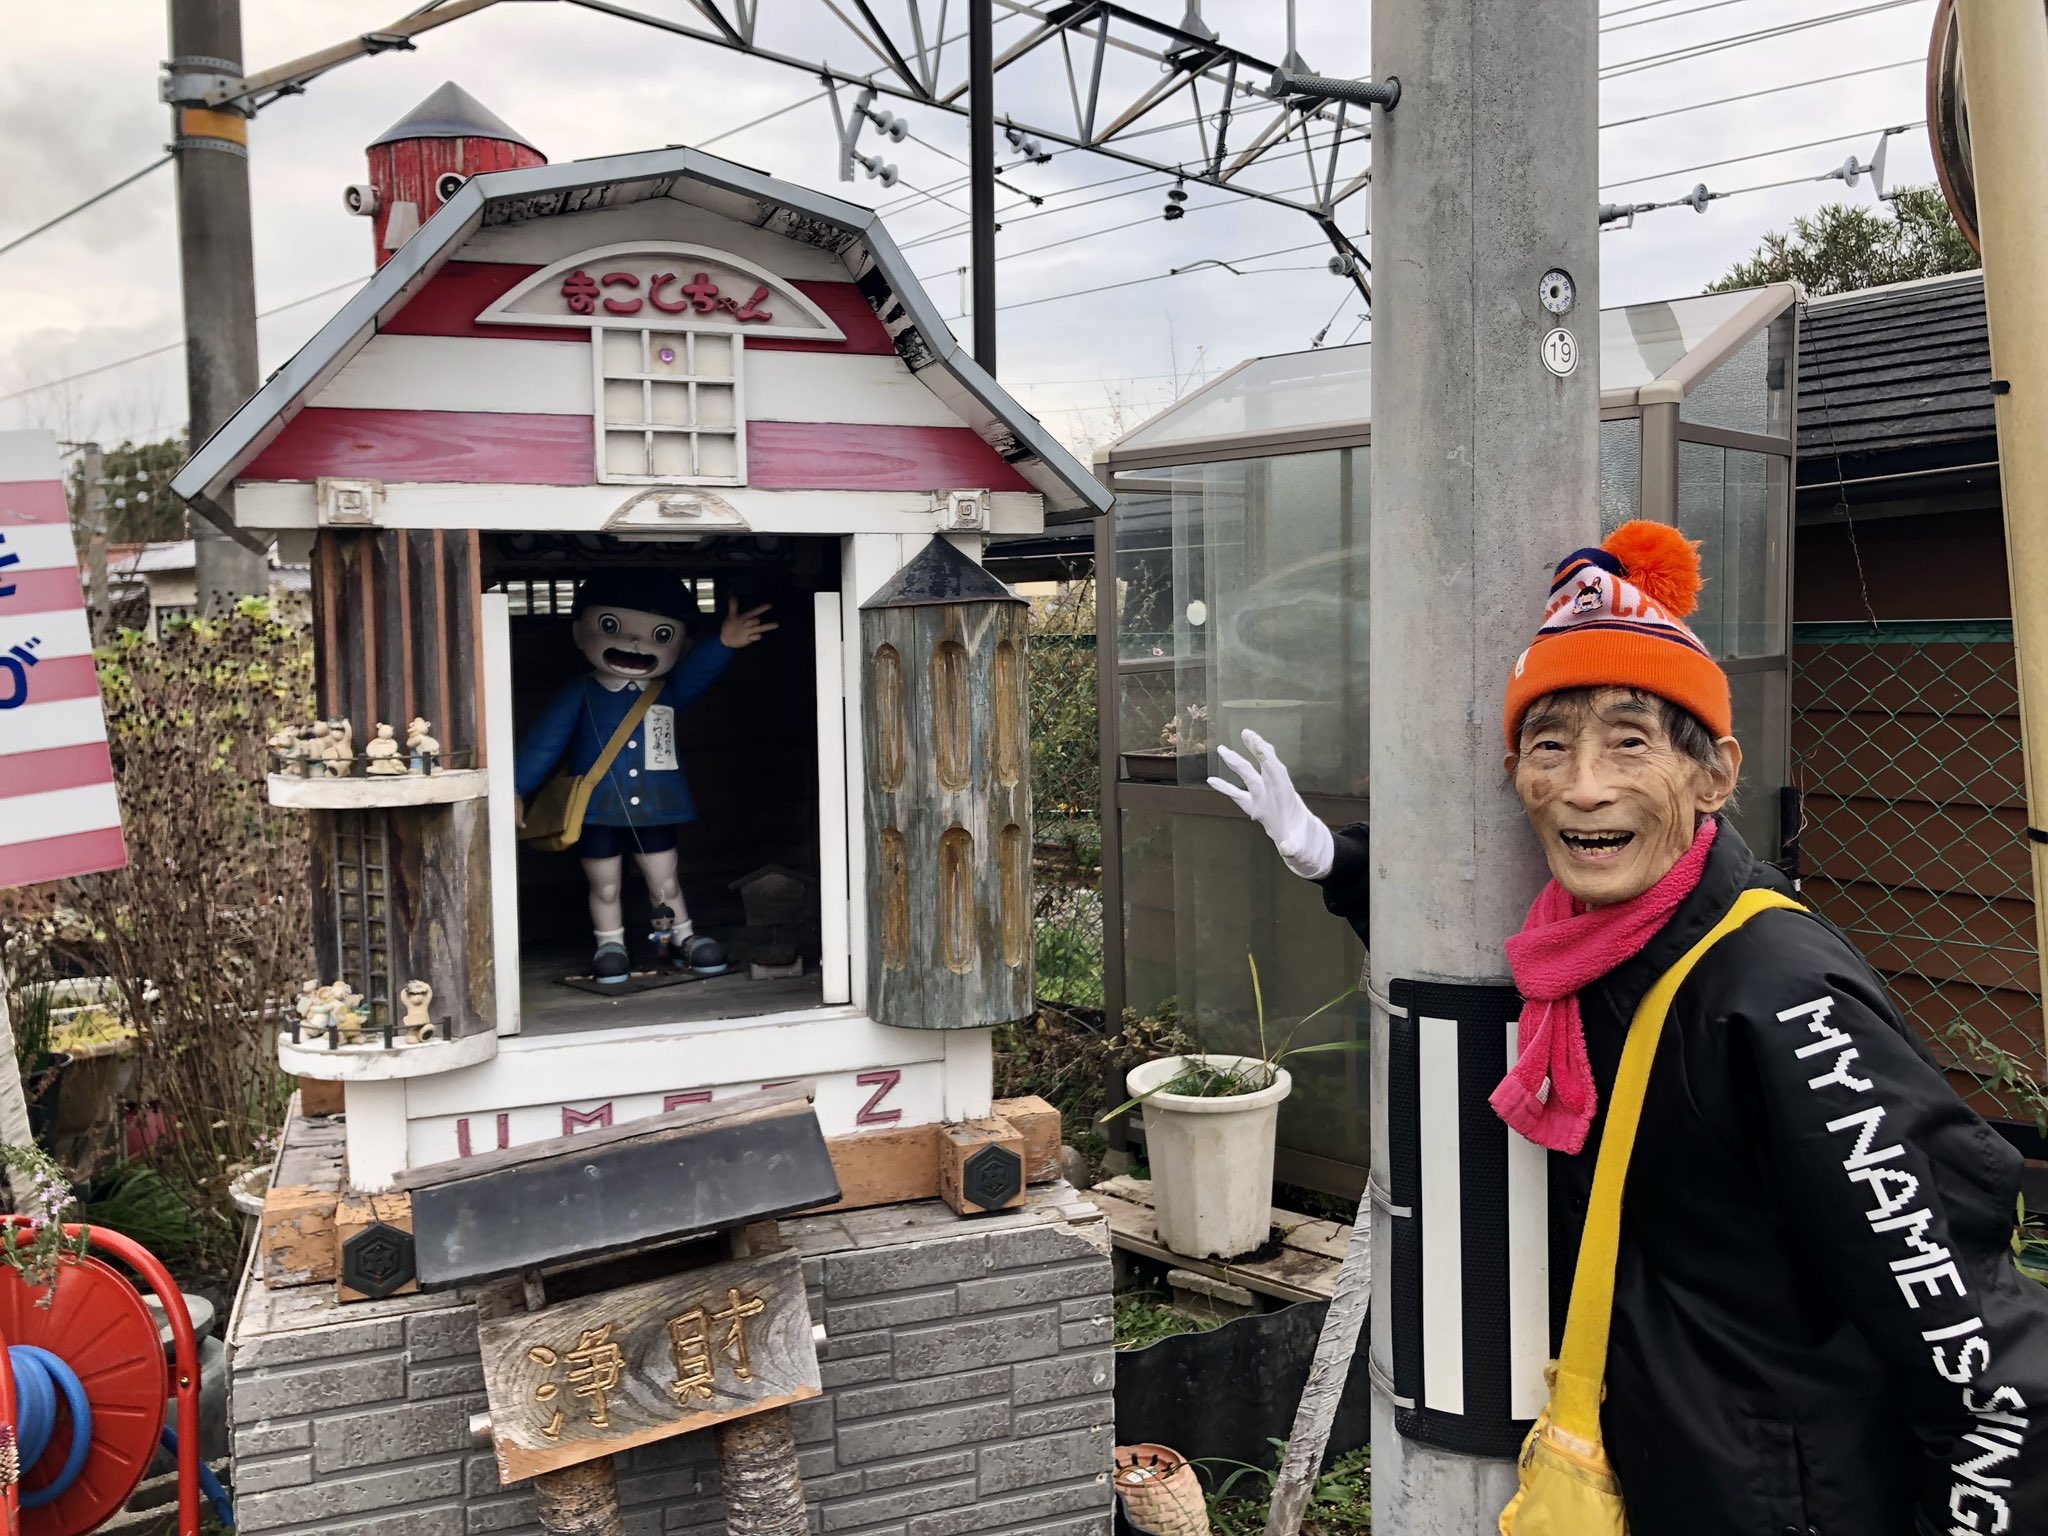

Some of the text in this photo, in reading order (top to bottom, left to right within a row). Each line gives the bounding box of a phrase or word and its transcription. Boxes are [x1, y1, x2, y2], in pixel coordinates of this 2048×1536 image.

[562, 270, 773, 322] まことちゃん
[1550, 341, 1572, 363] 19
[457, 1070, 902, 1158] UMZ
[1776, 996, 1874, 1092] MY
[1826, 1106, 1967, 1308] NAME
[1922, 1317, 1990, 1385] IS
